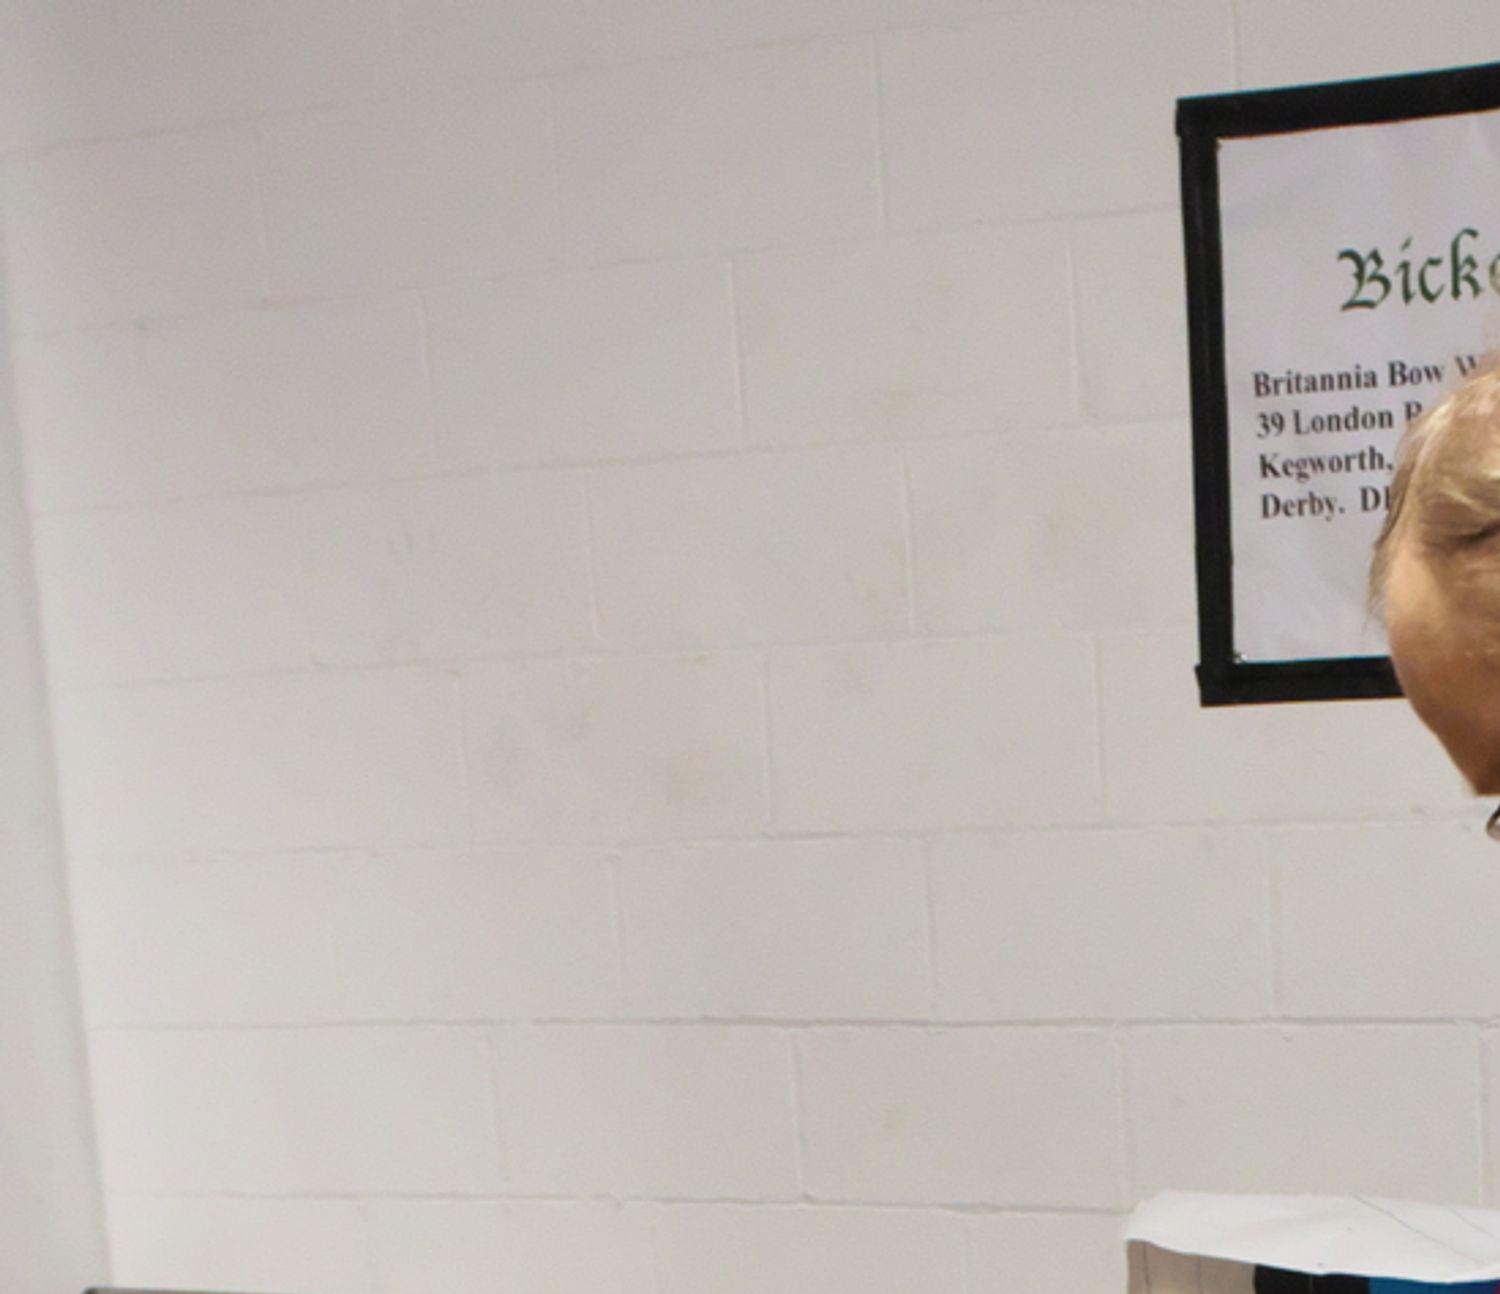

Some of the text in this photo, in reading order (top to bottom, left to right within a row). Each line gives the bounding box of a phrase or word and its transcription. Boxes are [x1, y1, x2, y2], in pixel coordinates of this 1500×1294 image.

[1252, 363, 1378, 398] Britannia
[1387, 360, 1444, 387] Bow
[1256, 411, 1286, 439] 39
[1293, 404, 1393, 435] London
[1259, 445, 1394, 484] Kegworth,
[1261, 490, 1346, 522] Derby.
